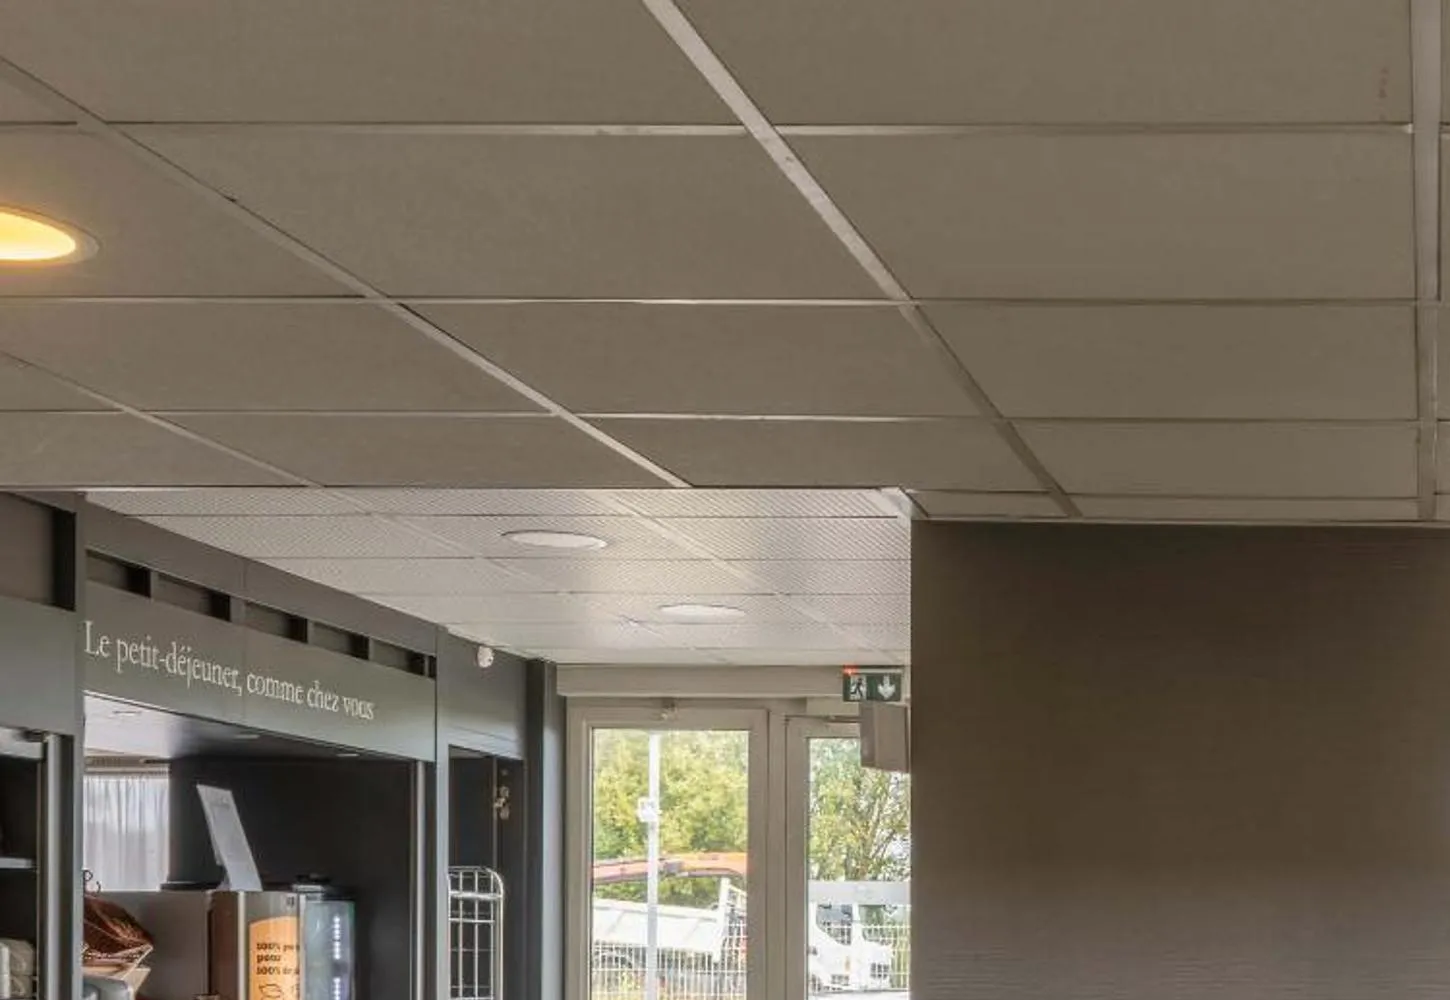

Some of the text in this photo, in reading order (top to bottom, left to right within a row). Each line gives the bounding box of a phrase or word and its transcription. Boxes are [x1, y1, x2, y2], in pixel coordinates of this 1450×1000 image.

[84, 620, 376, 720] Le petit-déjeuner, comme chez vous
